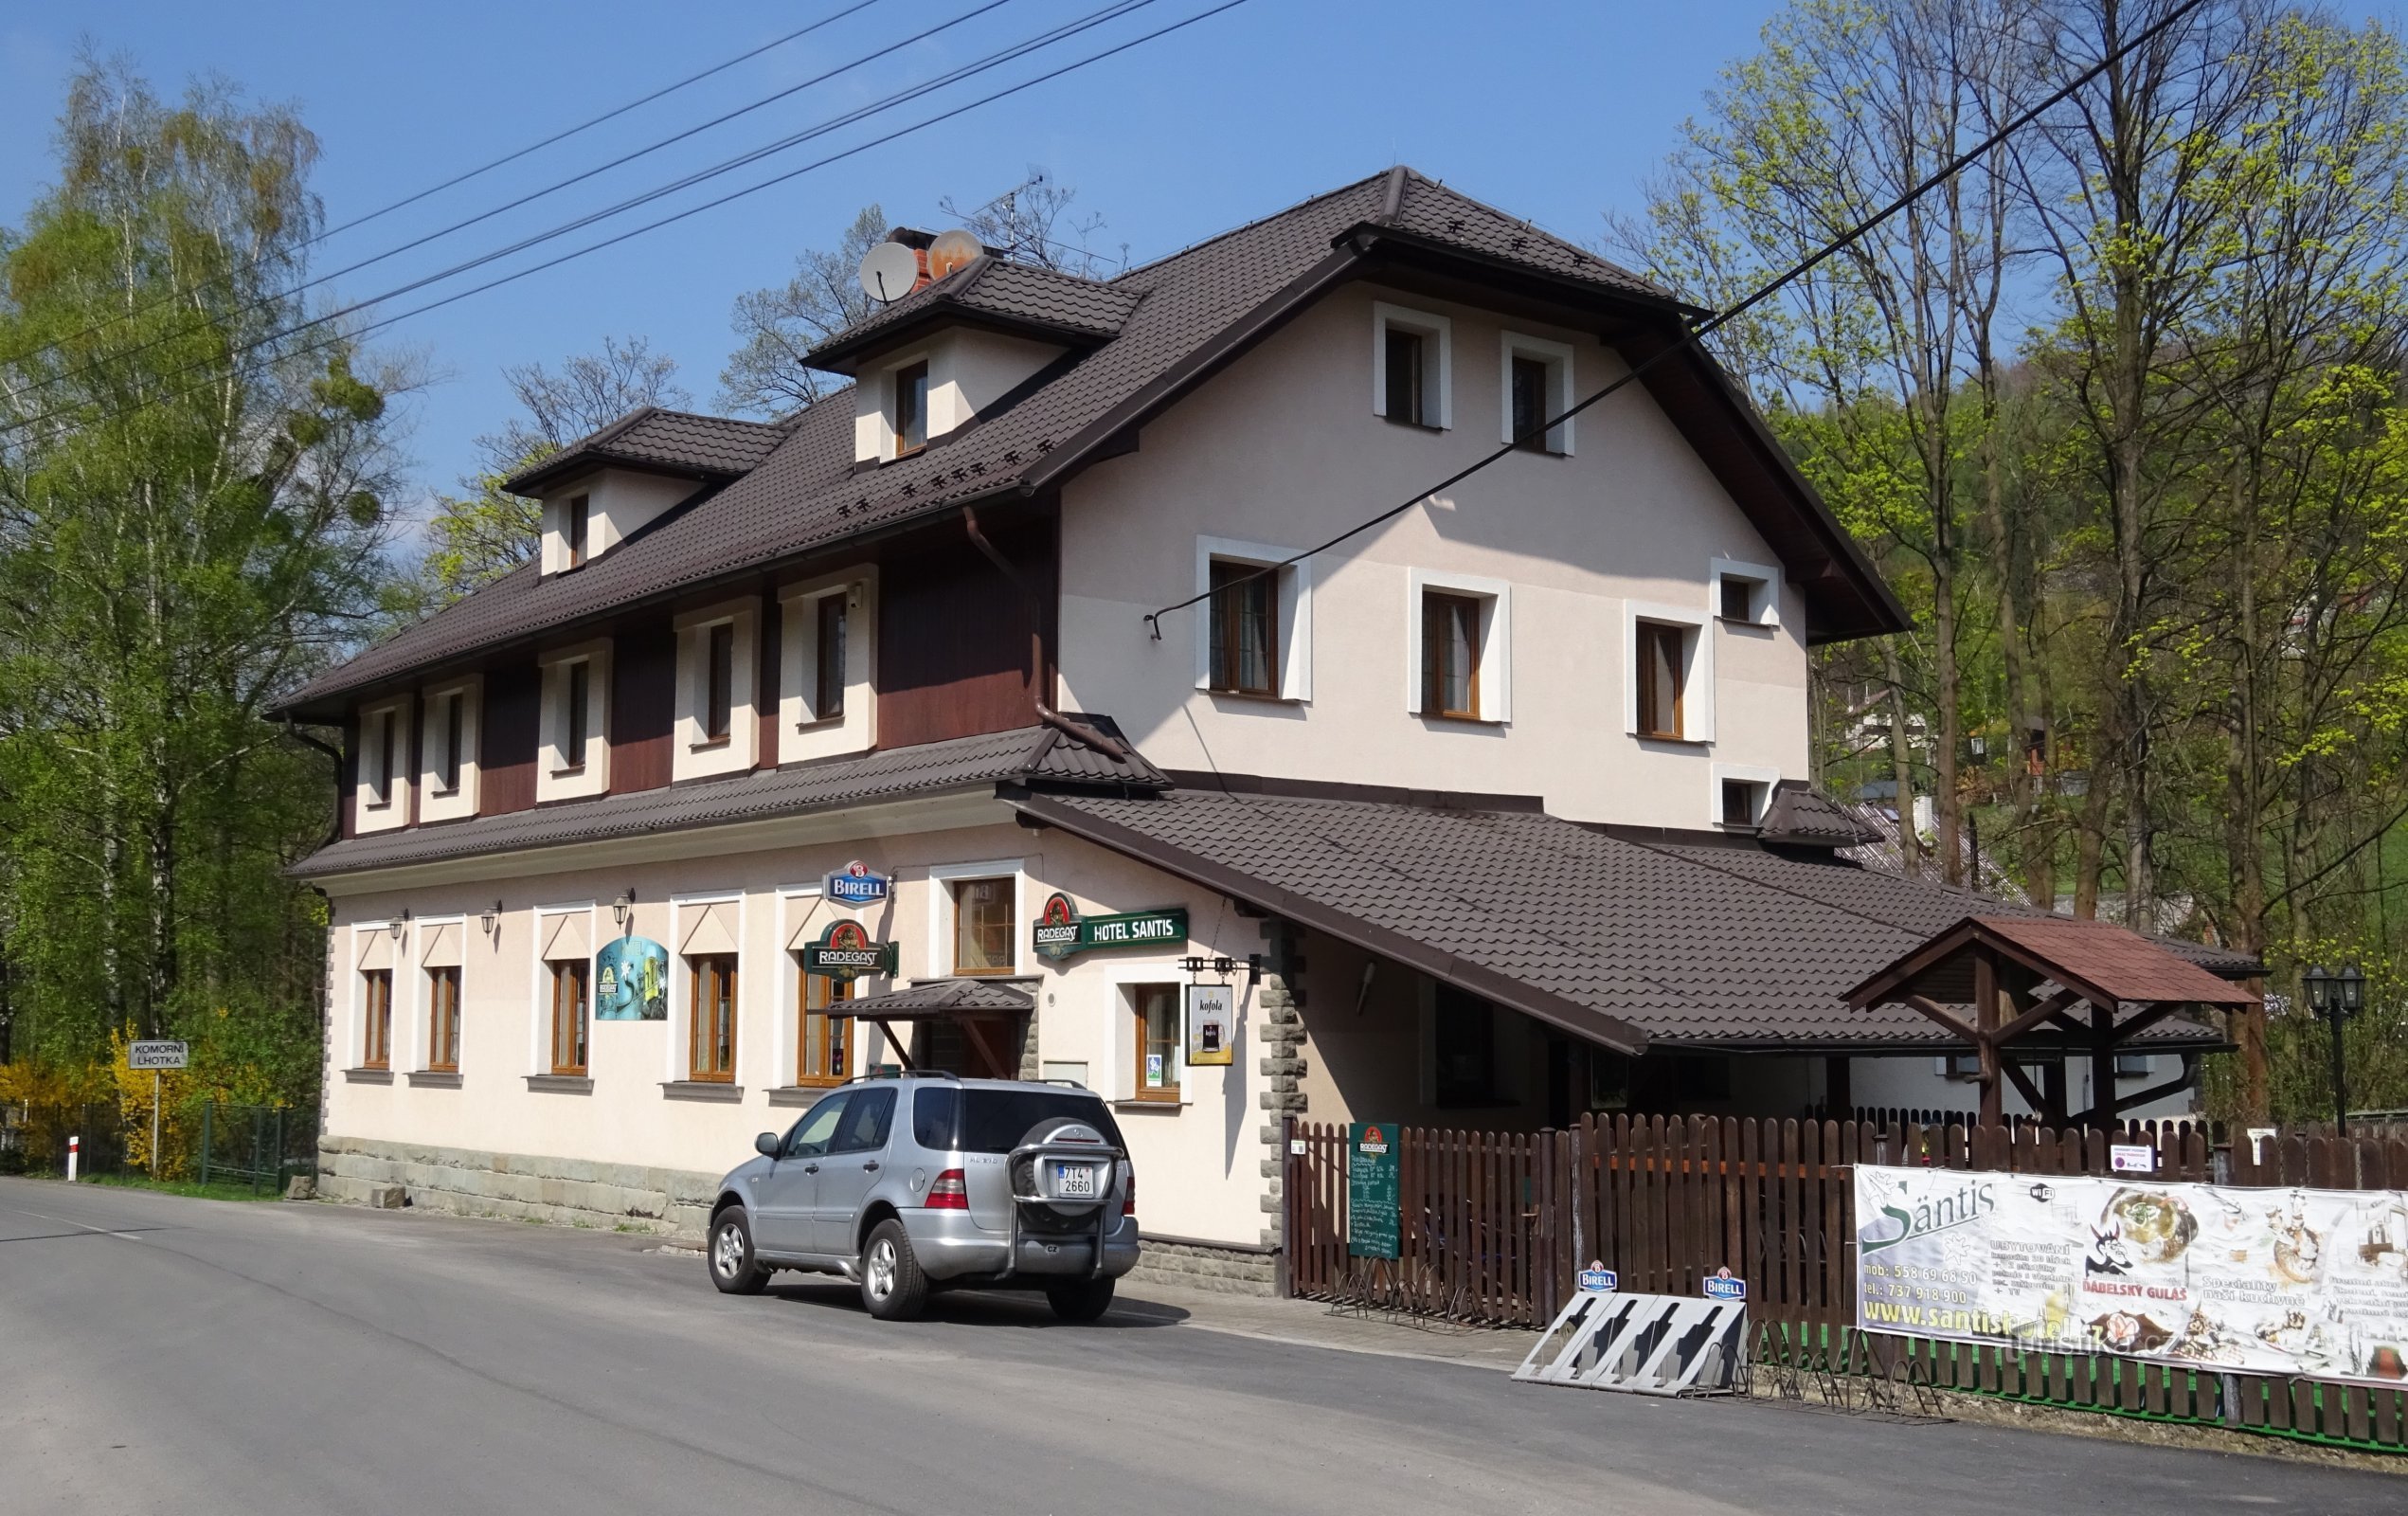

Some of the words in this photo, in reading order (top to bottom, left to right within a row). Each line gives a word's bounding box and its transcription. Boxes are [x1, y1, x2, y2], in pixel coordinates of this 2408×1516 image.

[834, 878, 884, 895] BIRELL
[1037, 926, 1077, 943] RADEGAST
[1094, 923, 1129, 941] HOTEL
[1132, 919, 1174, 938] SANTIS
[818, 950, 877, 966] RADEGAST
[1199, 1000, 1222, 1014] kofola
[137, 1056, 180, 1065] LHOTKA
[1066, 1168, 1083, 1180] 7T4
[1066, 1181, 1090, 1192] 2660
[1862, 1179, 1995, 1255] Säntis
[1582, 1273, 1613, 1286] BIRELL
[1864, 1264, 1889, 1277] mob:
[1895, 1266, 1918, 1279] 558
[1922, 1269, 1937, 1281] 69
[1942, 1270, 1956, 1282] 68
[1961, 1272, 1977, 1285] 50
[1708, 1280, 1741, 1294] BIRELL
[2202, 1276, 2277, 1292] Speciality
[1864, 1283, 1883, 1295] tel.:
[1888, 1284, 1911, 1298] 737
[1916, 1287, 1939, 1301] 918
[1943, 1290, 1967, 1304] 900
[2239, 1291, 2305, 1306] kuchyně
